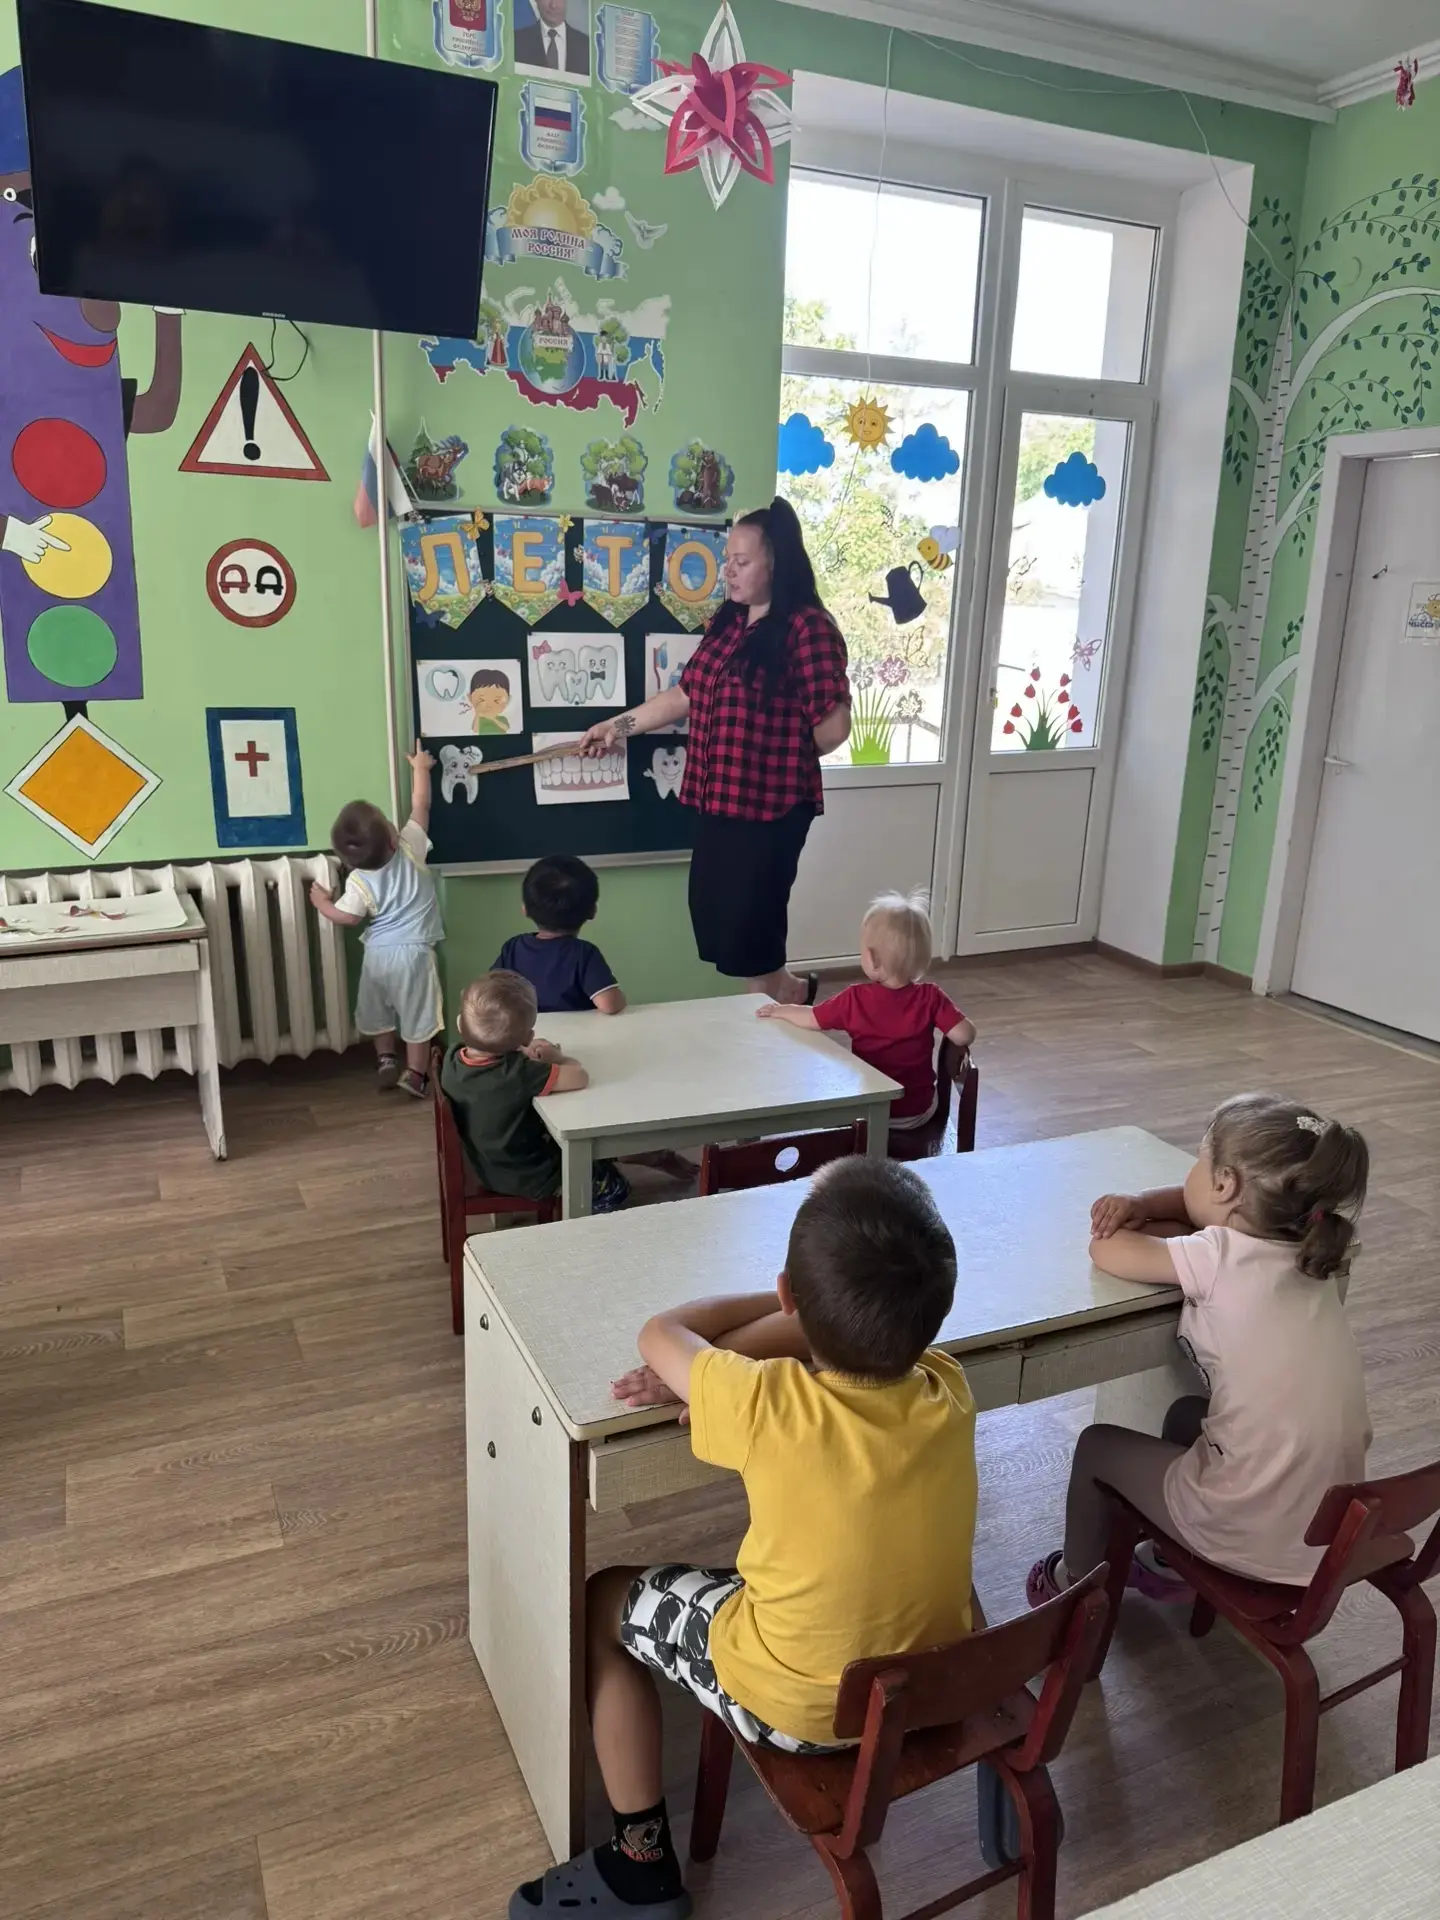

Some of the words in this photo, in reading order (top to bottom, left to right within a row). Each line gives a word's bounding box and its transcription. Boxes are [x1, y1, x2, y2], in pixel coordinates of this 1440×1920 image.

[511, 228, 538, 239] МОЯ
[541, 230, 585, 250] РОДИНА
[528, 242, 575, 258] РОССИЯ!
[418, 530, 718, 602] ЛЕТО
